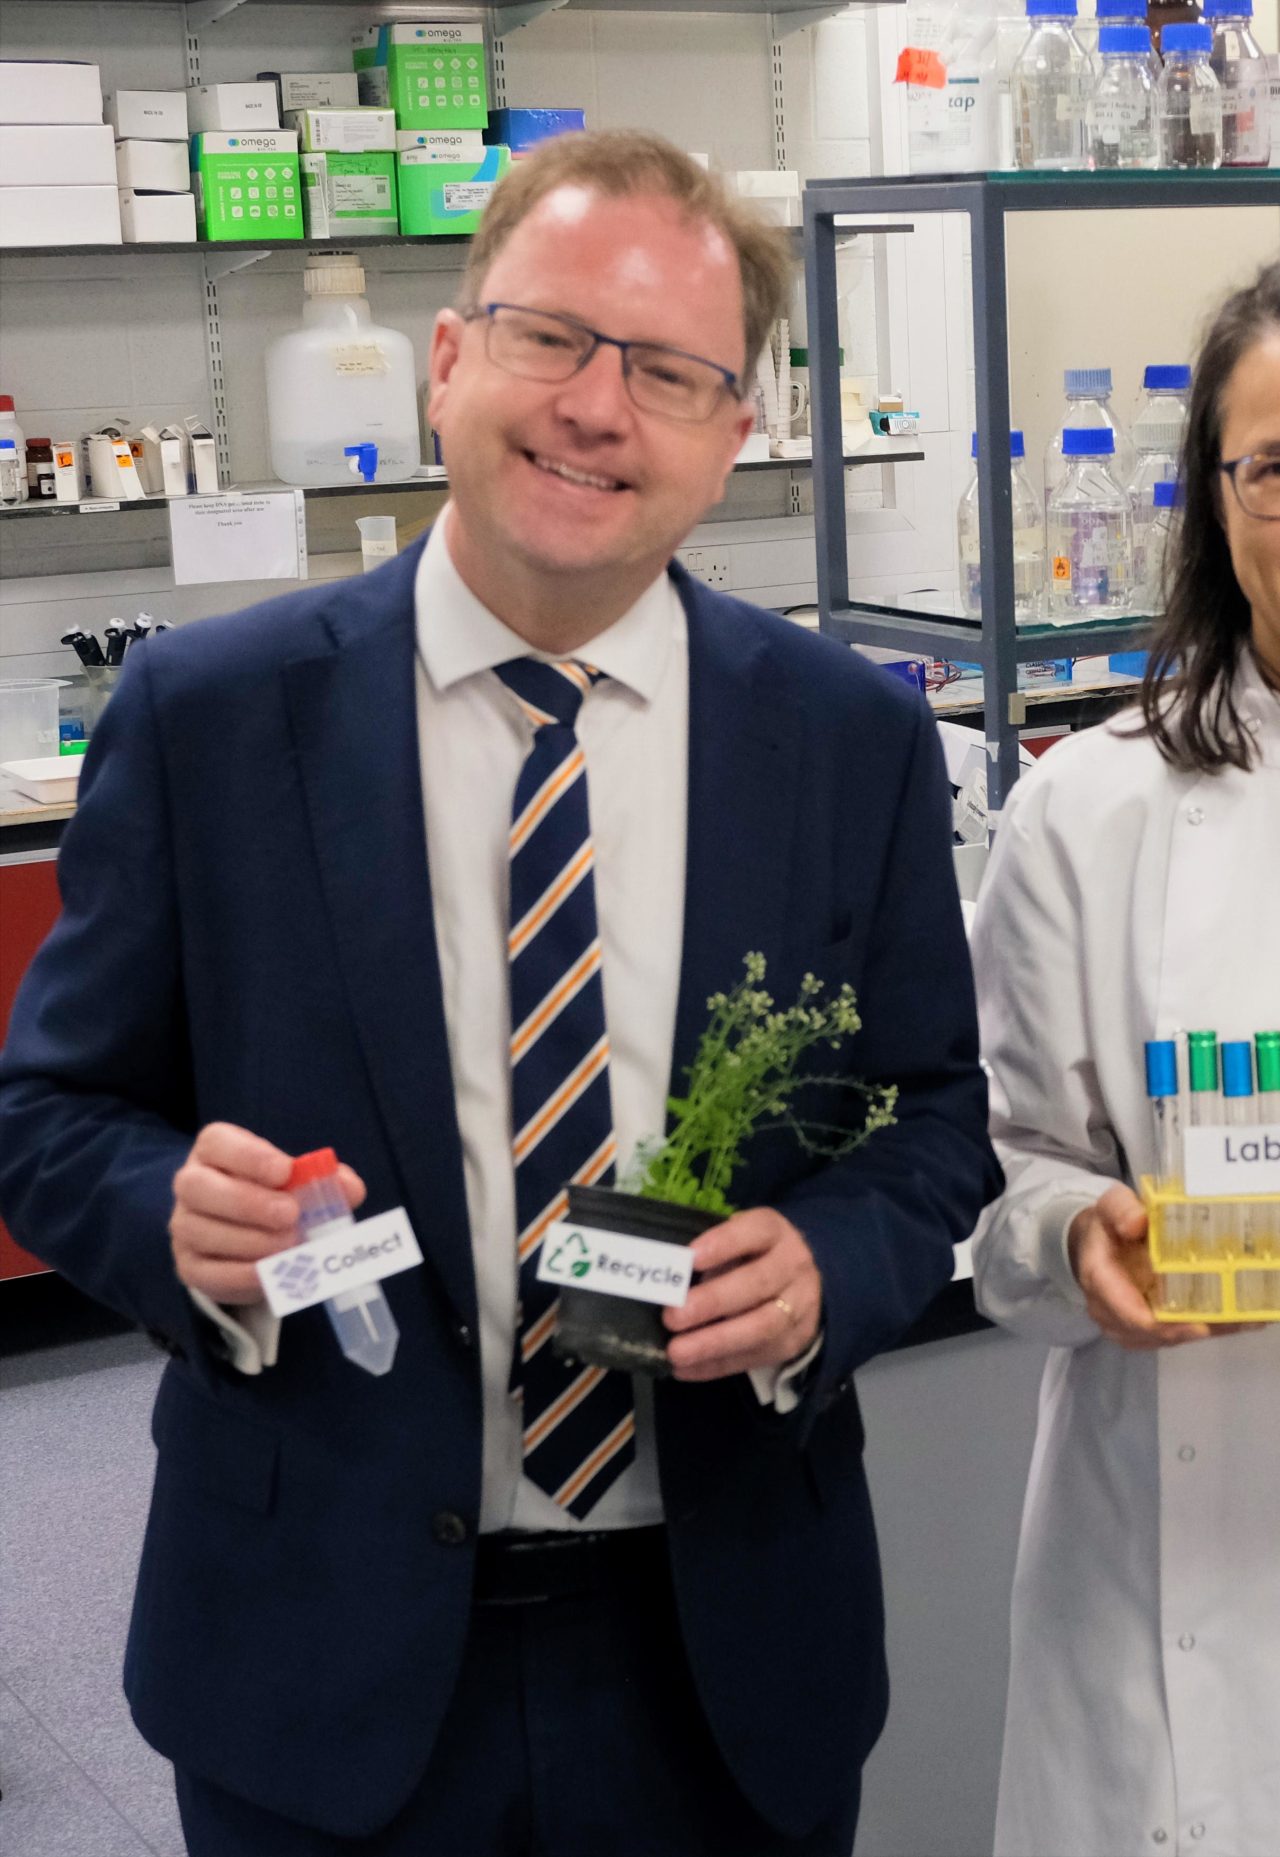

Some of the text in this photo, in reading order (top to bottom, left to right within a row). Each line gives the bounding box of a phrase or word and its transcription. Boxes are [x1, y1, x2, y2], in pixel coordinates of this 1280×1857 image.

[427, 29, 462, 39] omega
[240, 138, 277, 148] omega
[428, 136, 463, 145] omega
[322, 1232, 402, 1275] Collect
[597, 1252, 685, 1288] Recycle
